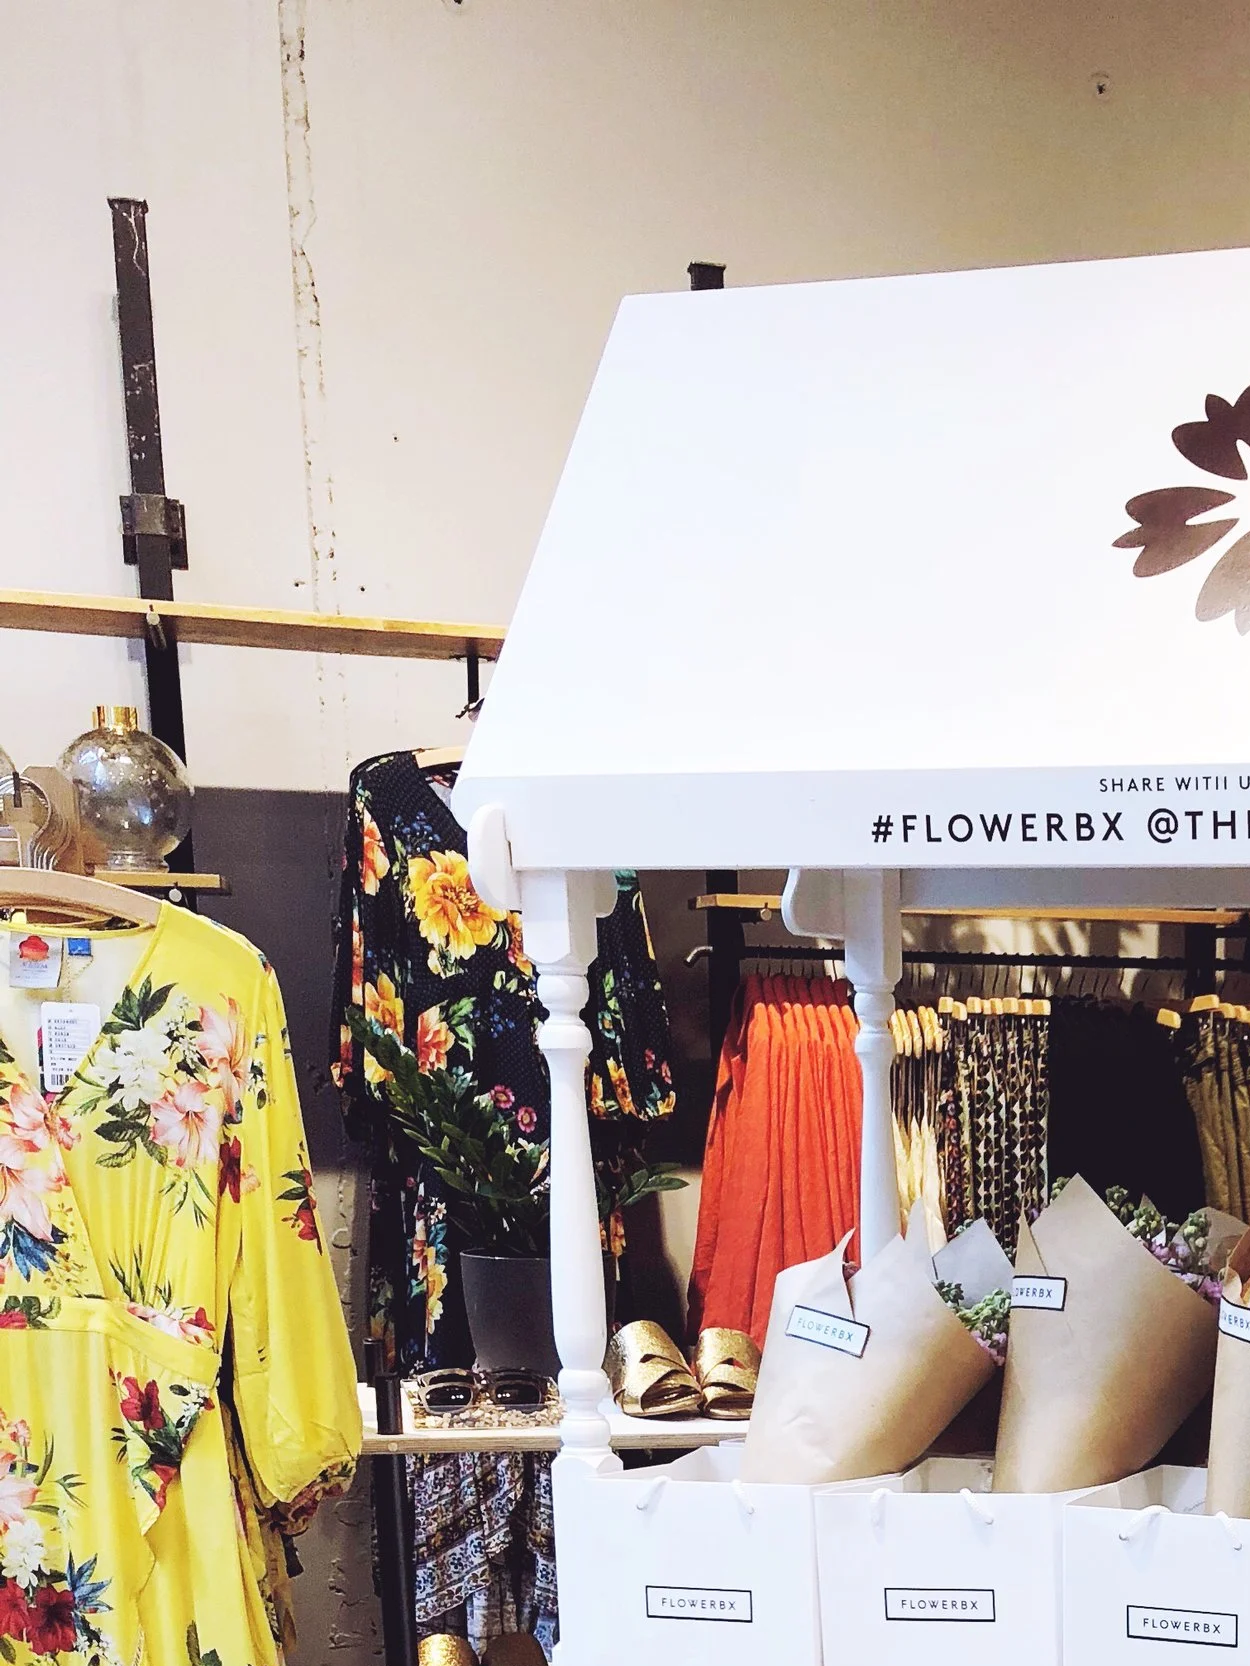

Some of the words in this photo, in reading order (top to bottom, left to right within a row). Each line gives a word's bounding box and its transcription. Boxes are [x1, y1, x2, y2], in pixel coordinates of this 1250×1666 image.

[1099, 777, 1165, 793] SHARE
[871, 812, 1125, 843] #FLOWERBX
[797, 1318, 854, 1343] FLOWERBX
[661, 1597, 737, 1611] FLOWERBX
[900, 1599, 979, 1611] FLOWERBX
[1142, 1617, 1222, 1635] FLOWERBX
